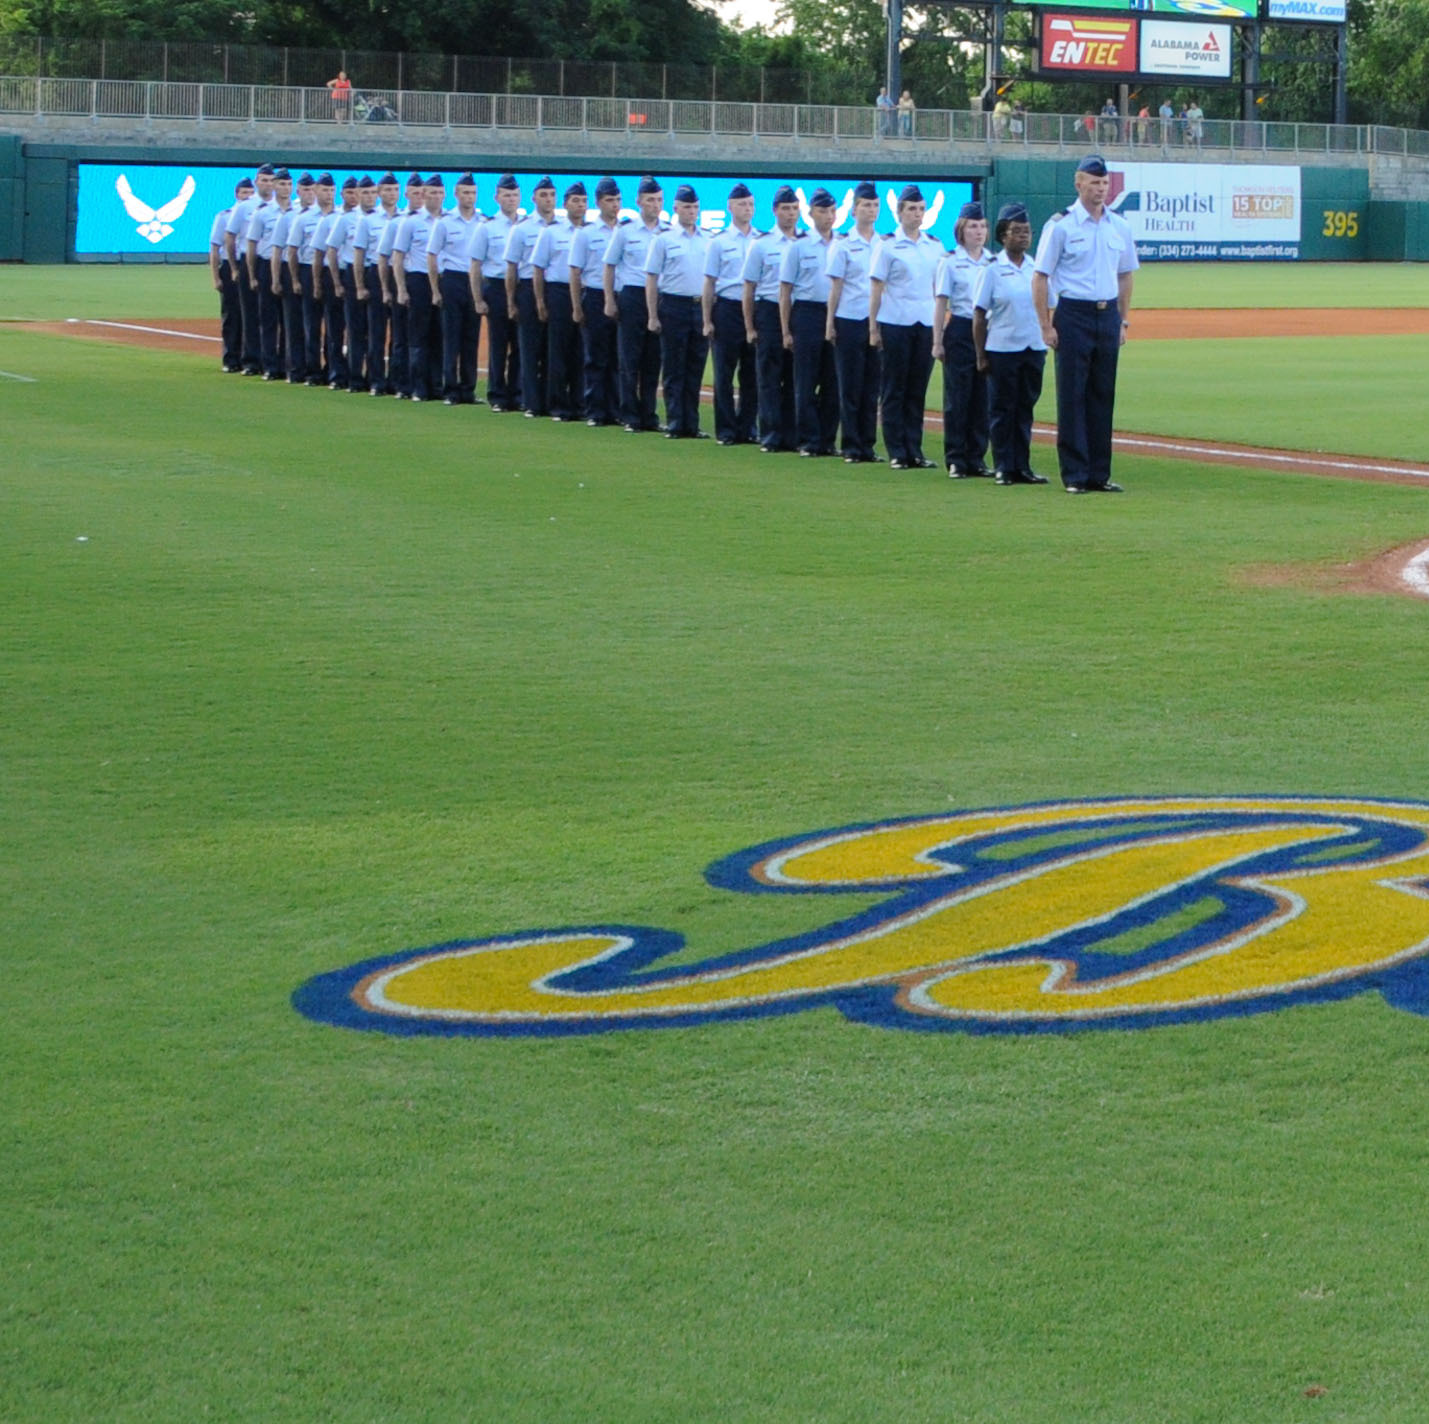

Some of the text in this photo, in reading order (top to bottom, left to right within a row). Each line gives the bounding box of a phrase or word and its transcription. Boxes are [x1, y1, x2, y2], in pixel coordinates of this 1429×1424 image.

[1270, 1, 1345, 17] myMAX.com
[1150, 39, 1200, 50] ALABAMA
[1049, 40, 1124, 66] ENTEC
[1184, 51, 1220, 62] POWER
[1144, 190, 1215, 217] Baptist
[1233, 196, 1282, 211] 15 TOP
[1144, 218, 1195, 232] HEALTH
[1322, 210, 1359, 237] 395
